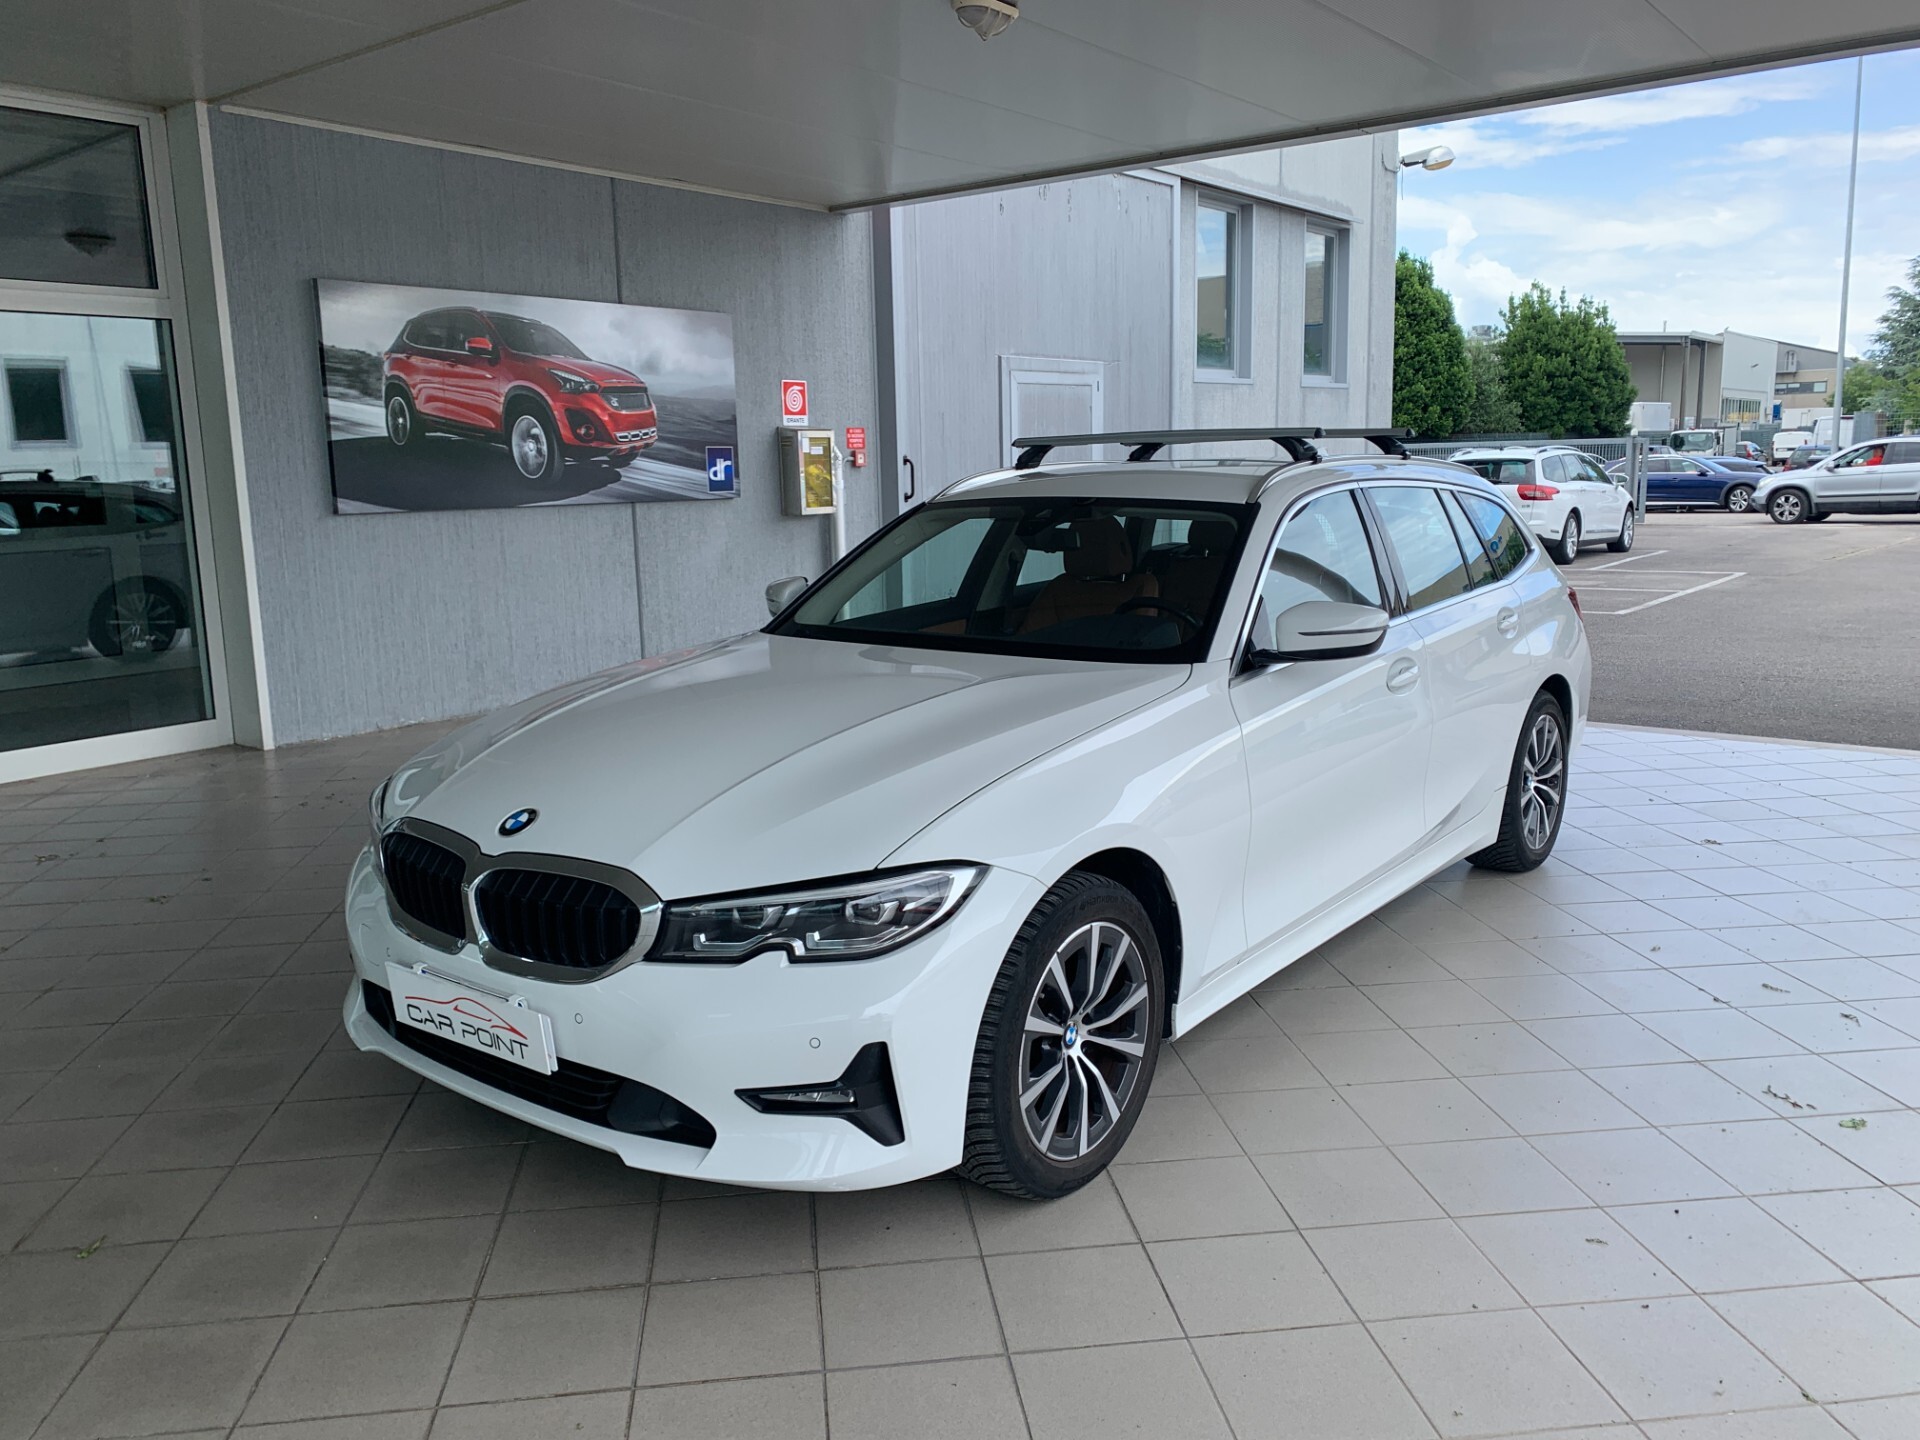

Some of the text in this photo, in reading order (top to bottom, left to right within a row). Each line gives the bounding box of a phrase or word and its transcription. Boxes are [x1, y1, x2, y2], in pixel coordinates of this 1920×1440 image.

[709, 458, 732, 481] dr
[407, 1003, 529, 1059] CAR POINT
